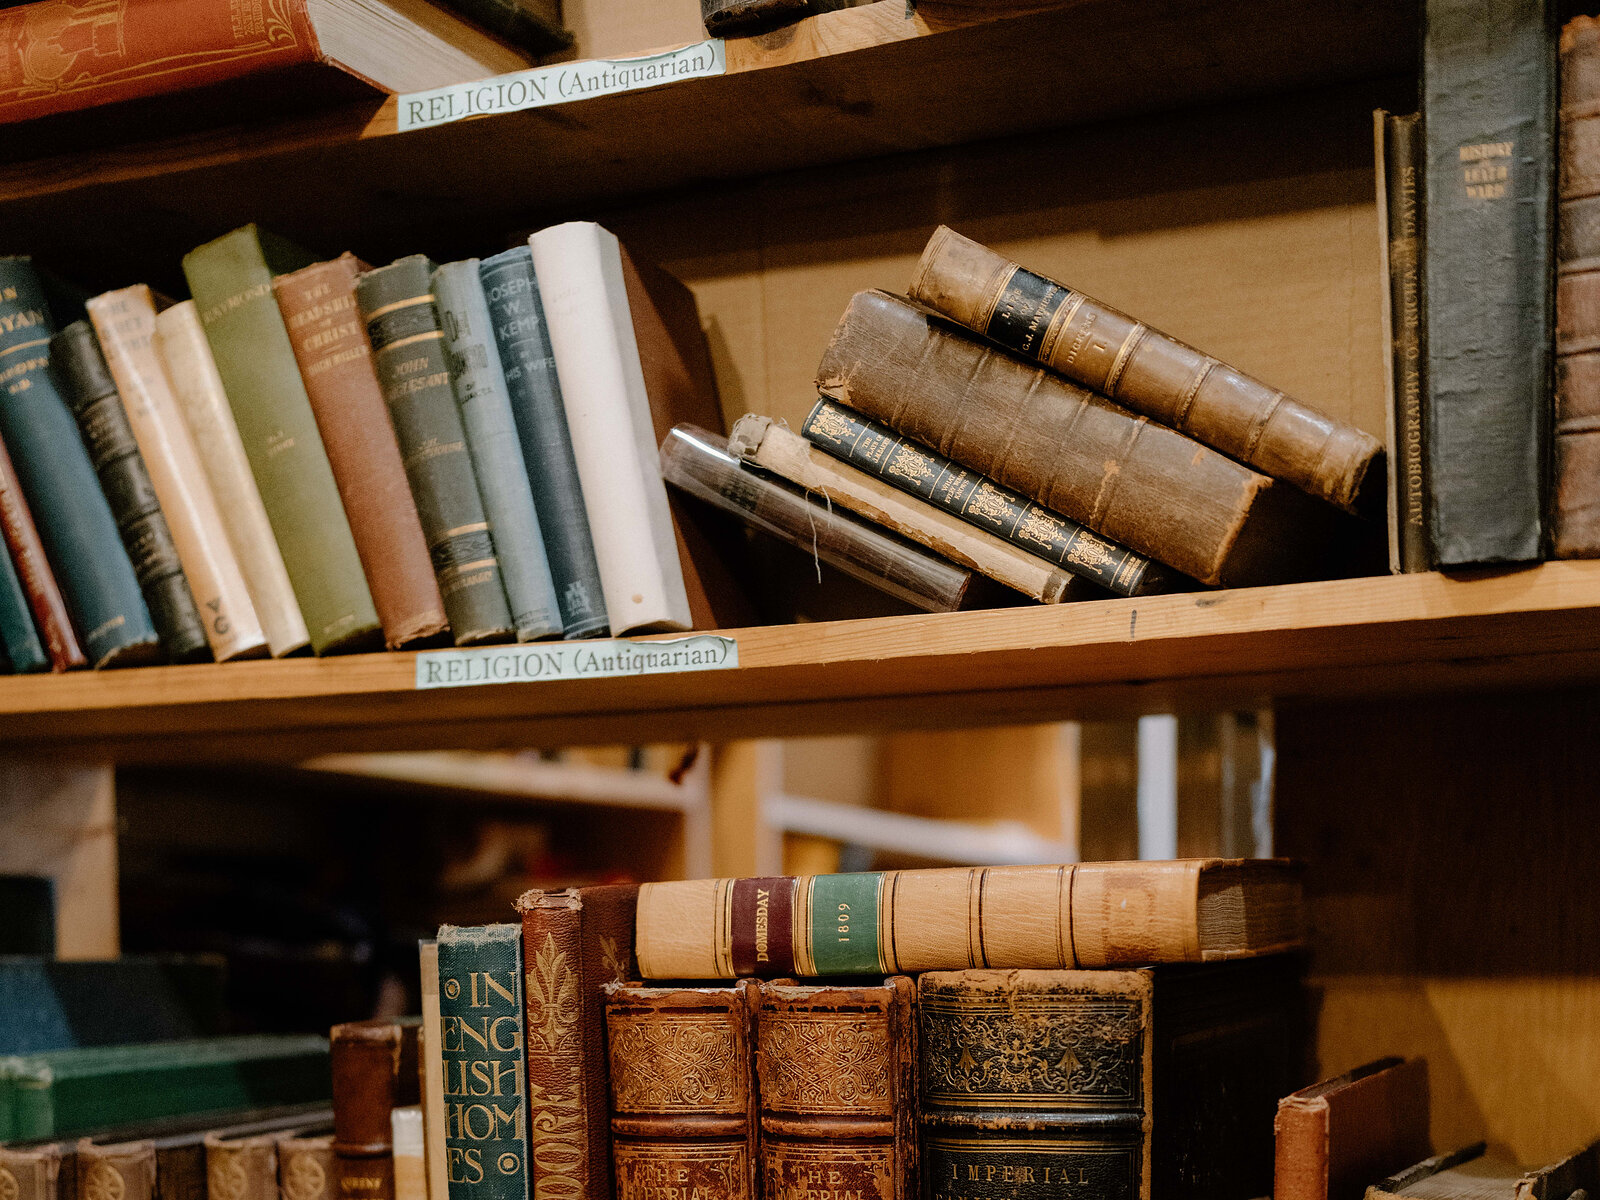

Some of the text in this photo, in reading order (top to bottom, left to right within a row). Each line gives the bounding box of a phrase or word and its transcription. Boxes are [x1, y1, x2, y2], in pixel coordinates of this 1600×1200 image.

[408, 44, 716, 125] RELIGION (Antiquarian)
[1402, 165, 1416, 234] DAVIES
[500, 315, 539, 341] KEMP
[1066, 312, 1098, 364] DICKENS
[862, 436, 873, 449] THE
[1406, 370, 1423, 526] AUTOBIOGRAPHY
[941, 474, 956, 492] WHAT
[954, 479, 970, 500] KNOWS
[426, 638, 728, 684] RELIGION (Antiquarian)
[755, 888, 770, 962] DOMESDAY
[838, 903, 850, 942] 1809
[469, 971, 516, 1008] IN
[442, 1015, 522, 1053] ENG
[443, 1059, 522, 1098] LISH
[445, 1103, 522, 1141] HOM
[447, 1147, 484, 1184] ES
[643, 1164, 689, 1182] THE
[794, 1164, 841, 1185] THE
[952, 1163, 1089, 1185] IMPERIAL
